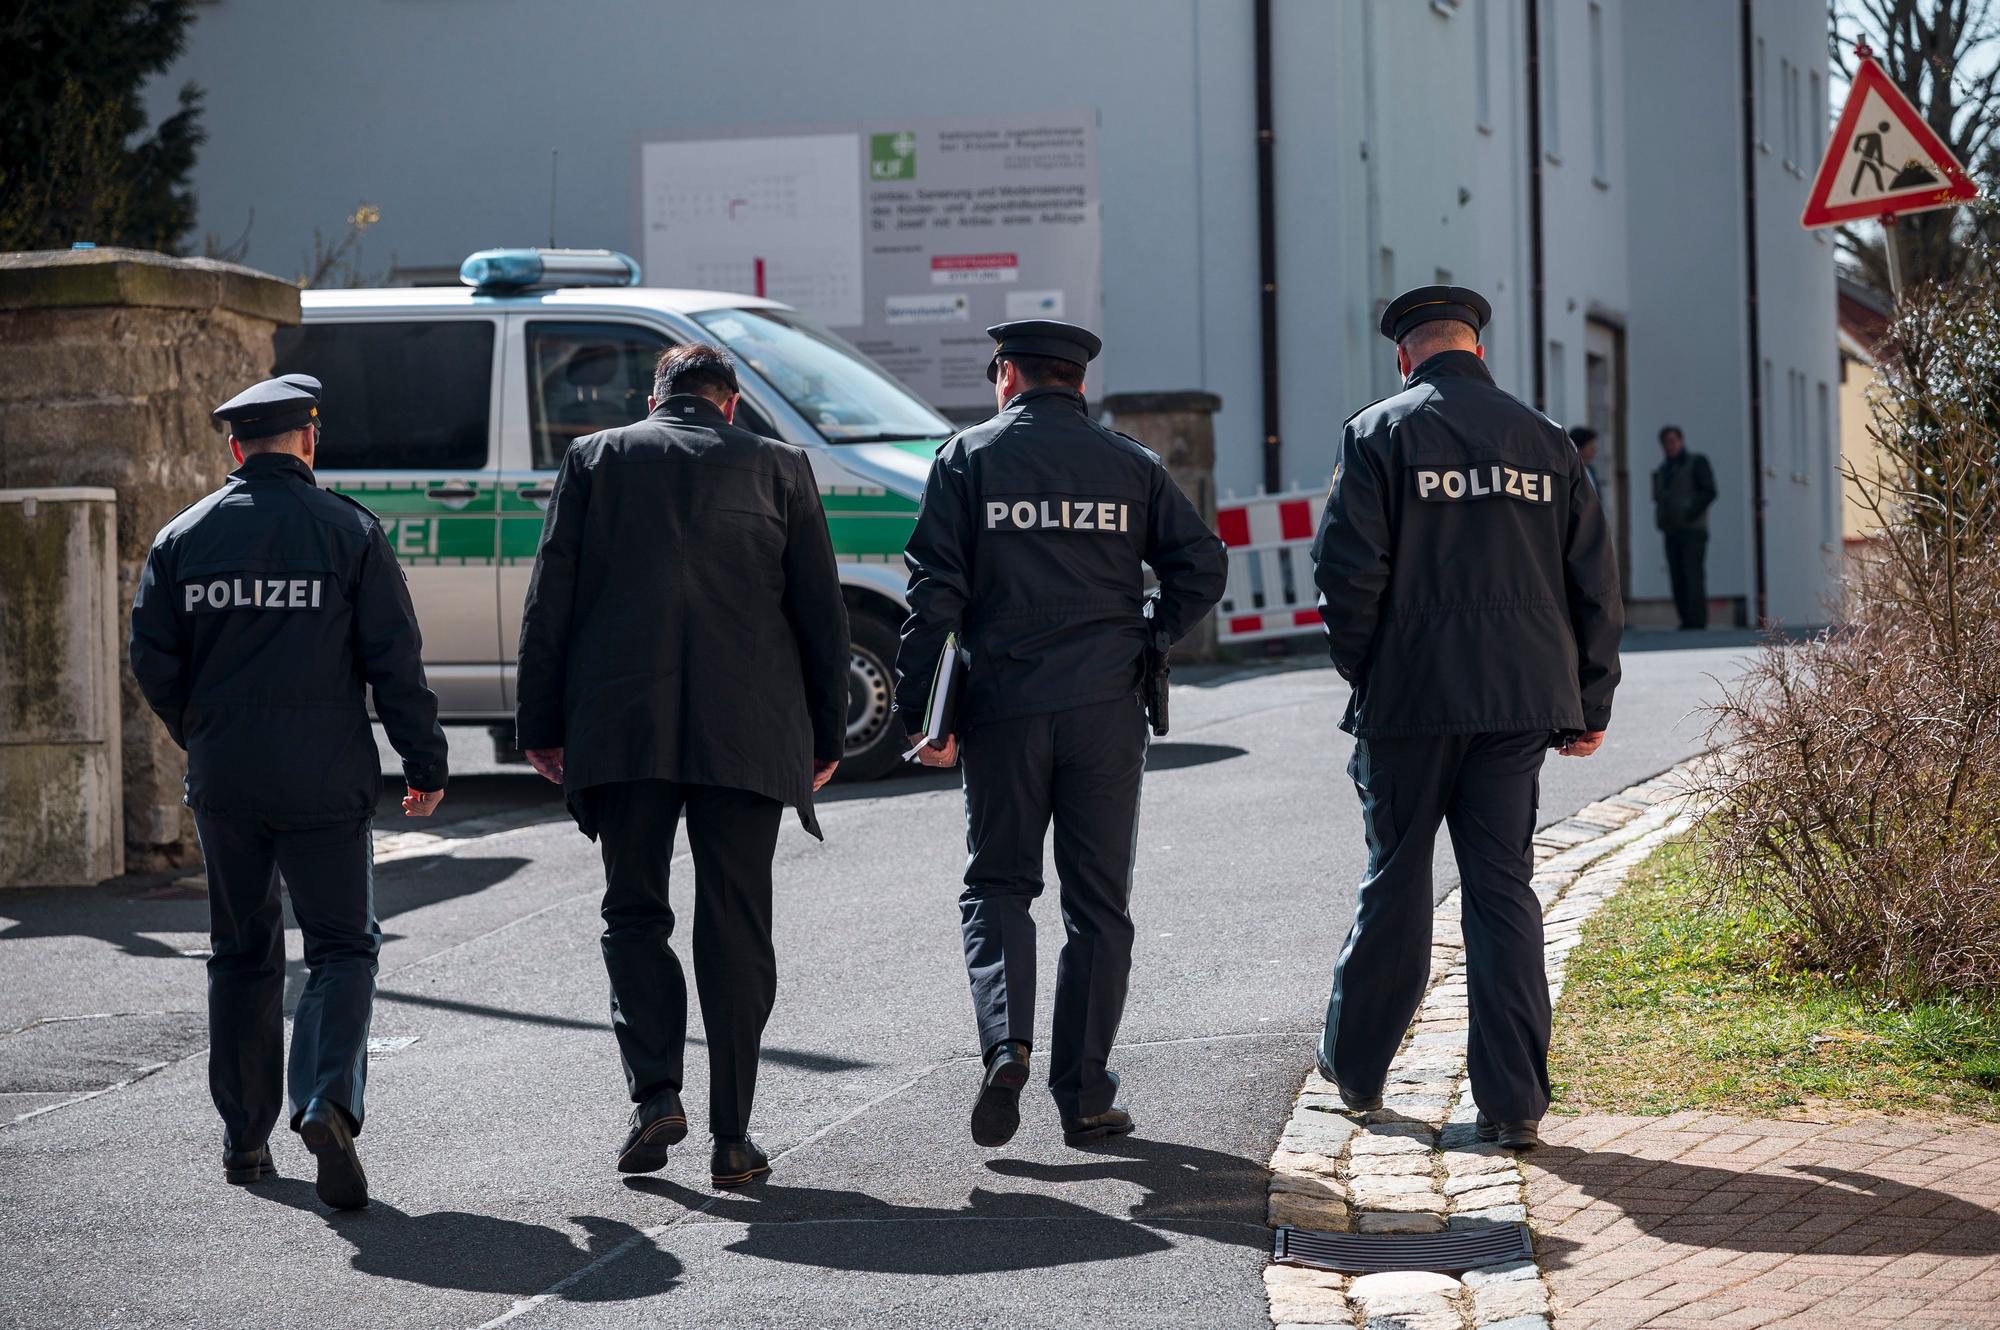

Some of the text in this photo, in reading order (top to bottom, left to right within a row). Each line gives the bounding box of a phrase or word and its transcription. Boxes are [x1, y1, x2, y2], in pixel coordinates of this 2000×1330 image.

[872, 159, 904, 177] KJF
[1417, 466, 1552, 502] POLIZEI
[986, 501, 1128, 532] POLIZEI
[185, 579, 321, 612] POLIZEI
